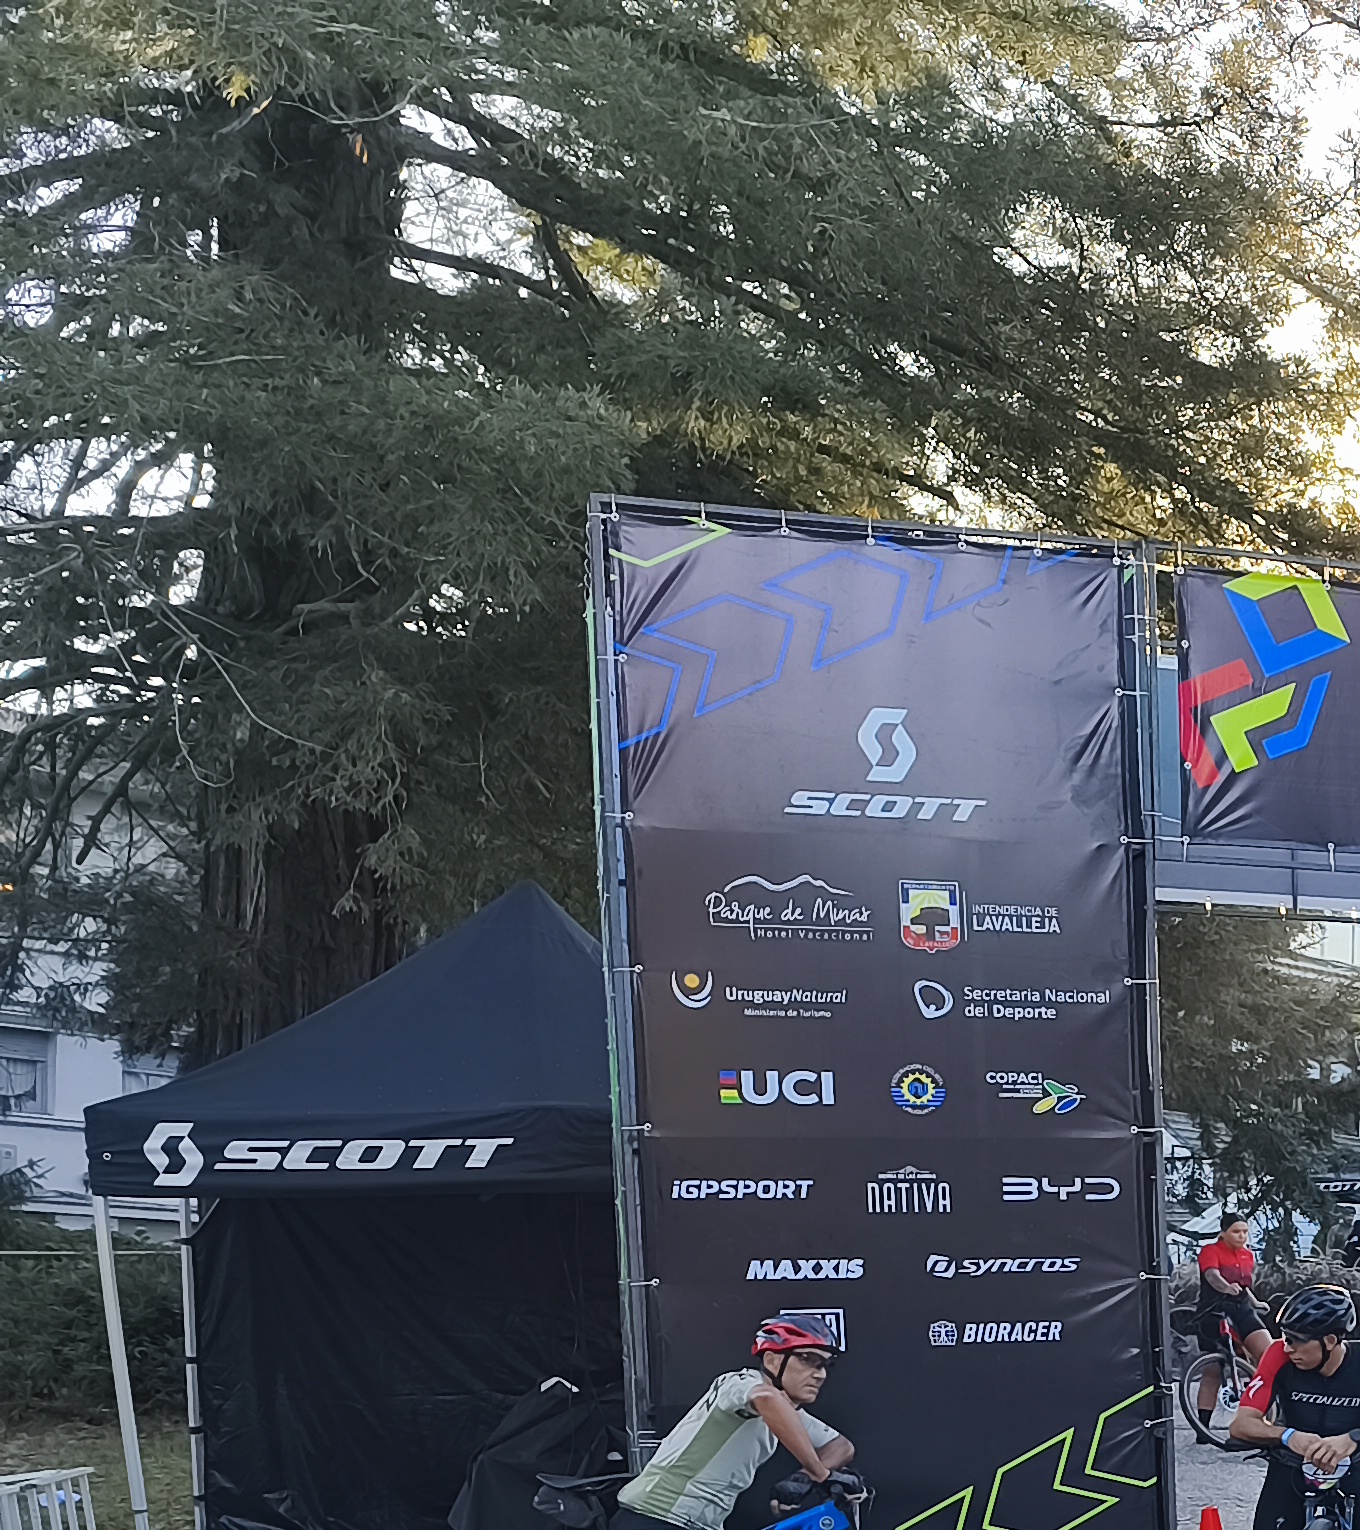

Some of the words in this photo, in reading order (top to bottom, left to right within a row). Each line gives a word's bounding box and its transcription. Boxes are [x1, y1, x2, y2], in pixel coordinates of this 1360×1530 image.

[783, 789, 987, 822] SCOTT
[705, 891, 774, 940] Parque
[780, 899, 804, 921] de
[812, 898, 872, 925] Minas
[972, 904, 1042, 916] INTENDENCIA
[1044, 907, 1060, 917] DE
[757, 928, 792, 938] Hotel
[799, 929, 873, 941] Vacacional
[972, 915, 1061, 934] LAVALLEJA
[725, 986, 847, 1004] UruguayNatural
[963, 986, 1041, 1002] Secretaria
[1045, 988, 1110, 1004] Nacional
[744, 1008, 785, 1017] Ministerio
[787, 1009, 798, 1017] de
[799, 1009, 832, 1018] Turismo
[964, 1003, 989, 1017] del
[992, 1004, 1057, 1020] Deporte
[740, 1069, 835, 1106] UCI
[985, 1072, 1043, 1084] COPACI
[213, 1137, 514, 1170] SCOTT
[670, 1179, 813, 1200] iGPSPORT
[867, 1182, 951, 1213] NATIVA
[1002, 1177, 1121, 1201] BYD
[745, 1258, 865, 1280] MAXXIS
[962, 1321, 1063, 1344] BIORACER
